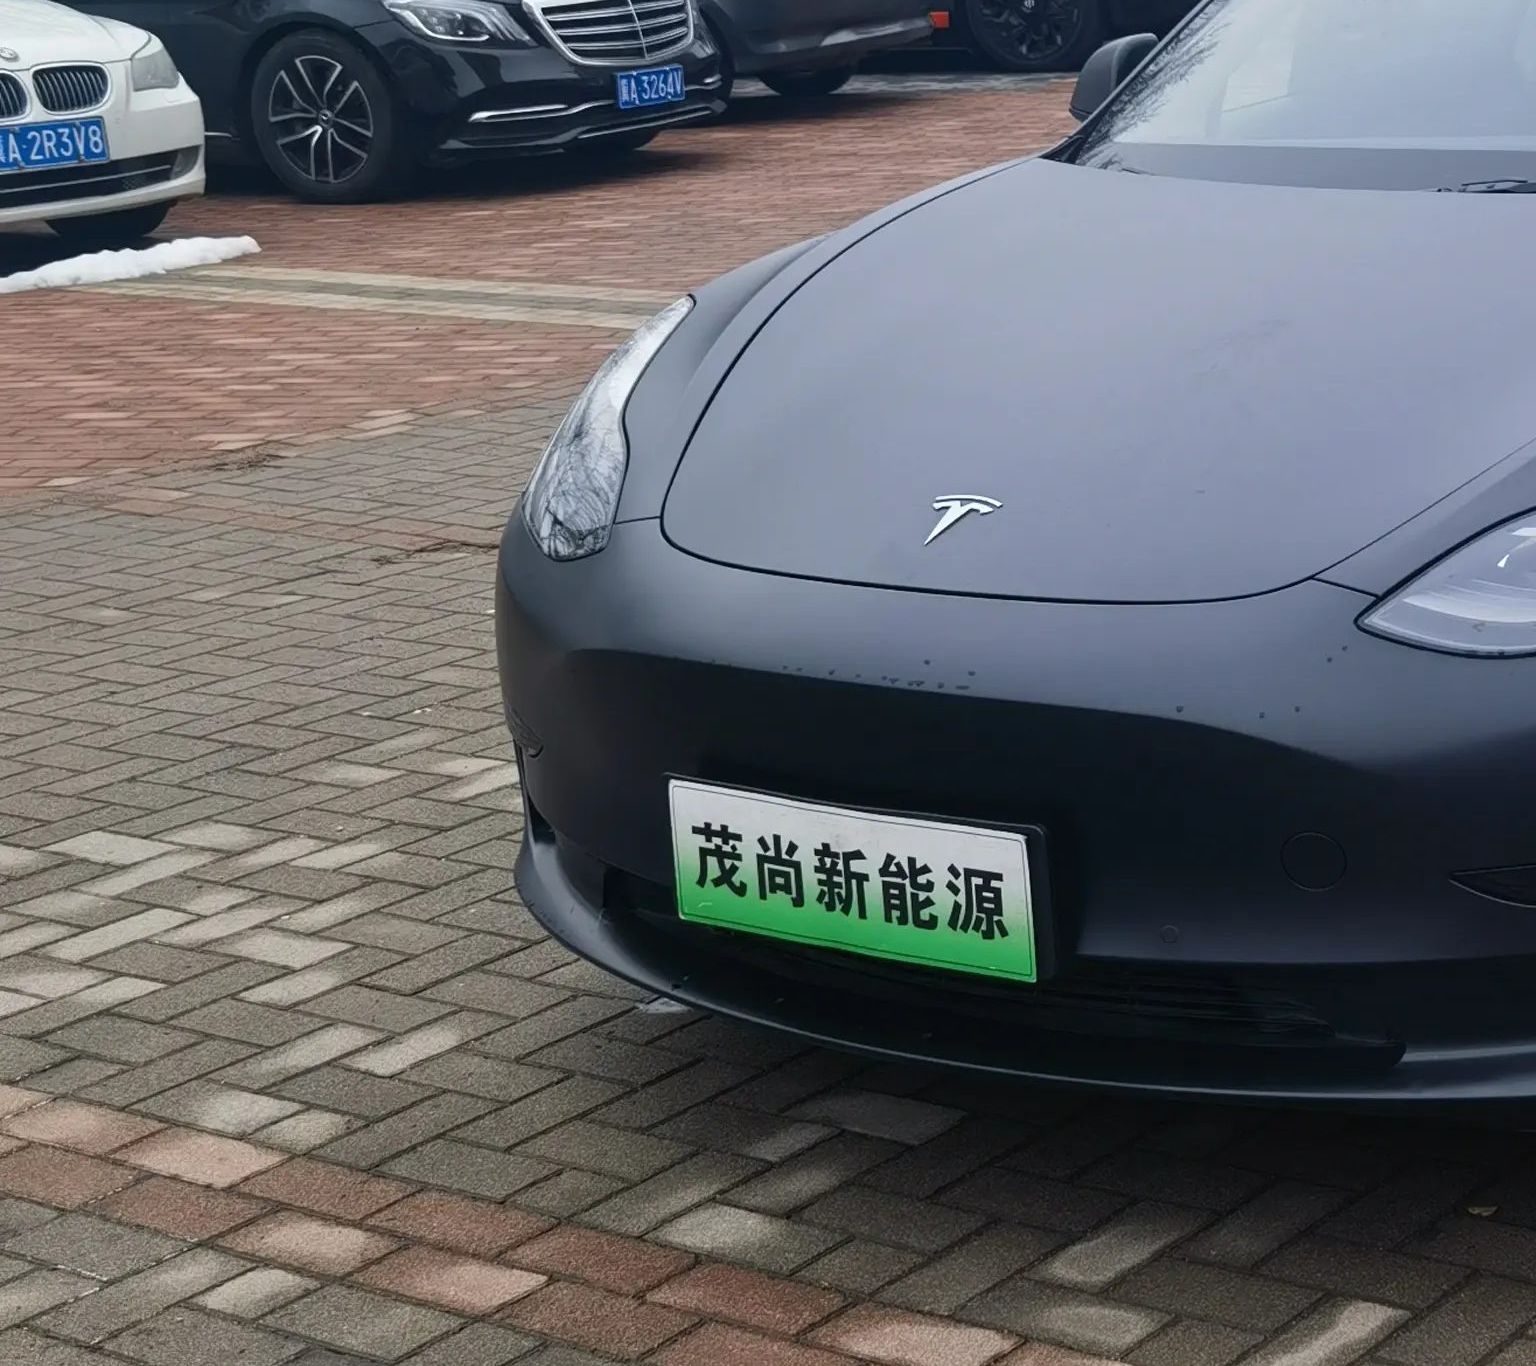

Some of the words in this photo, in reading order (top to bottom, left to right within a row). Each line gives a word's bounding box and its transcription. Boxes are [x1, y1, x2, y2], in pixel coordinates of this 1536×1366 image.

[692, 822, 1009, 940] 茂尚新能源
